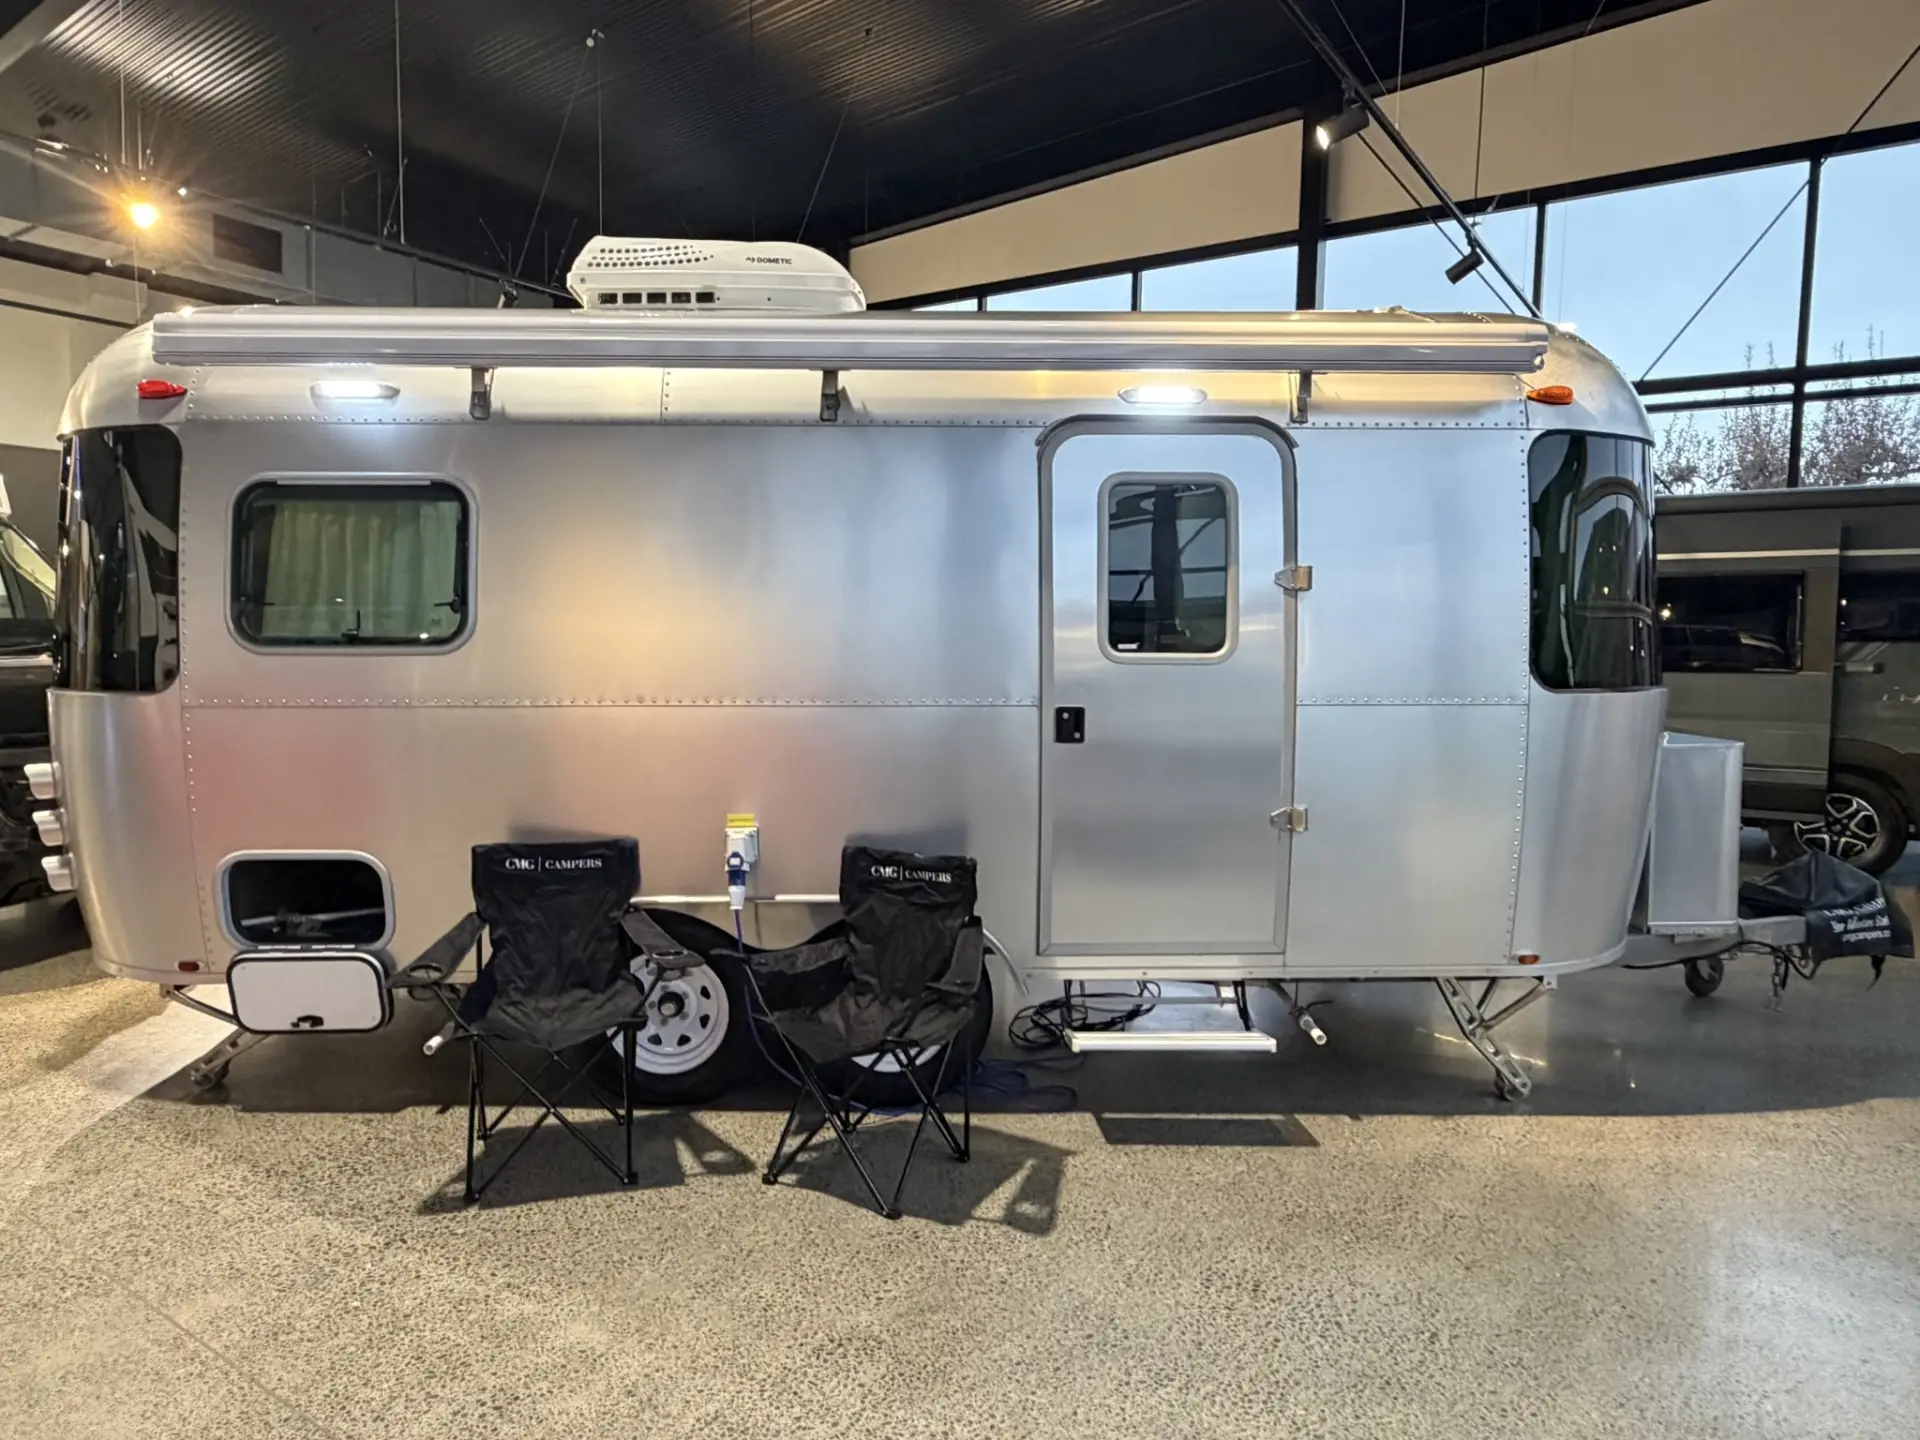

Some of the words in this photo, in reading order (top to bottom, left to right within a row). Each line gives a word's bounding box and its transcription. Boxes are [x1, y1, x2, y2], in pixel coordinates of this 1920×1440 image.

[756, 256, 792, 265] DOMETIC
[504, 857, 536, 871] CMG
[544, 857, 603, 870] CAMPERS
[870, 864, 899, 878] CMG
[904, 868, 952, 884] CAMPERS
